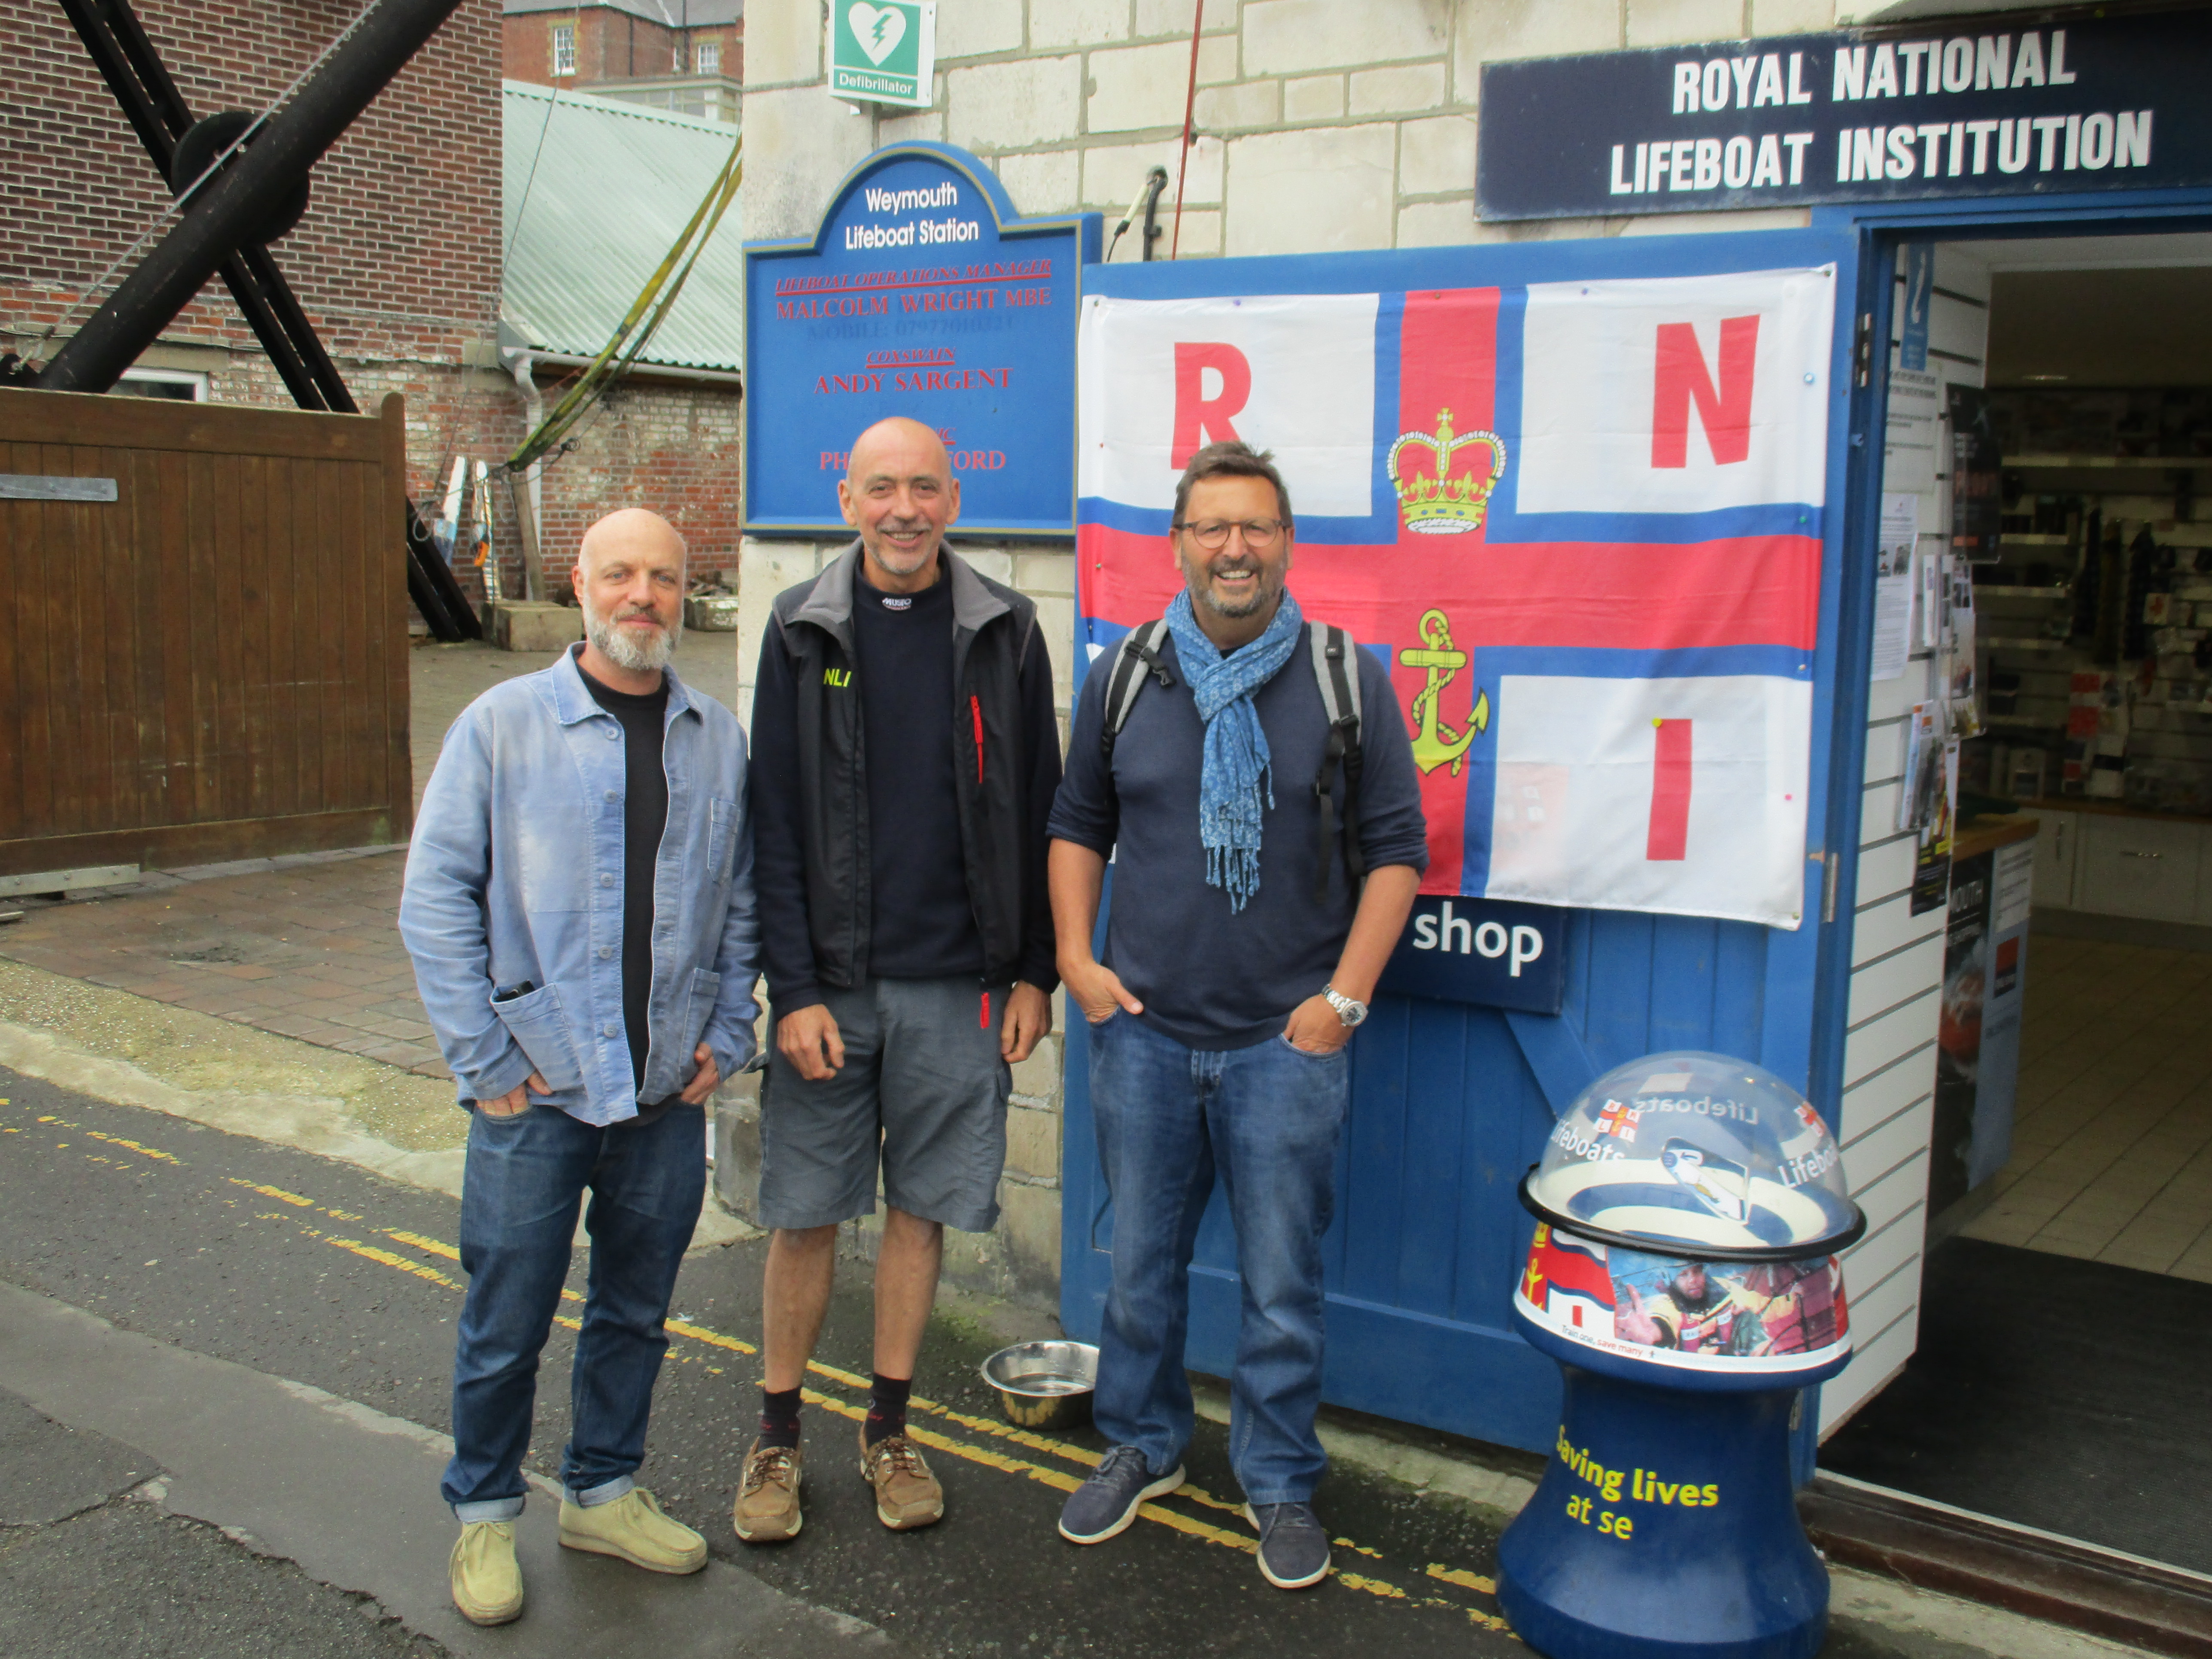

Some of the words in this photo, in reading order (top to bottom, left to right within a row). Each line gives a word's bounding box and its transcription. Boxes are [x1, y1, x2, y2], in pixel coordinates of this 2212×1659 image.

[839, 73, 913, 95] Defibrillator
[1672, 51, 1811, 114] ROYAL
[1832, 30, 2076, 103] NATIONAL
[1610, 133, 1812, 194] LIFEBOAT
[1837, 110, 2154, 182] INSTITUTION
[866, 182, 957, 215] Weymouth
[846, 222, 914, 249] Lifeboat
[919, 218, 979, 244] Station
[776, 273, 851, 292] LIFEBOAT
[854, 267, 958, 286] OPERATIONS
[963, 259, 1051, 278] MANAGER
[776, 296, 888, 320] MALCOLM
[901, 289, 998, 313] WRIGHT
[1006, 288, 1052, 307] MBE
[866, 347, 957, 364] COXSWAIN
[814, 373, 886, 395] ANDY
[895, 368, 1014, 391] SARGENT
[1171, 342, 1251, 469] R
[1651, 314, 1760, 468] N
[820, 452, 849, 470] PH
[823, 668, 851, 687] NLI
[1647, 718, 1692, 860] I
[1413, 901, 1543, 977] shop
[1562, 1324, 1579, 1338] Train
[1597, 1339, 1617, 1349] save
[1618, 1345, 1644, 1358] many
[1632, 1468, 1719, 1507] lives
[1566, 1494, 1593, 1525] at
